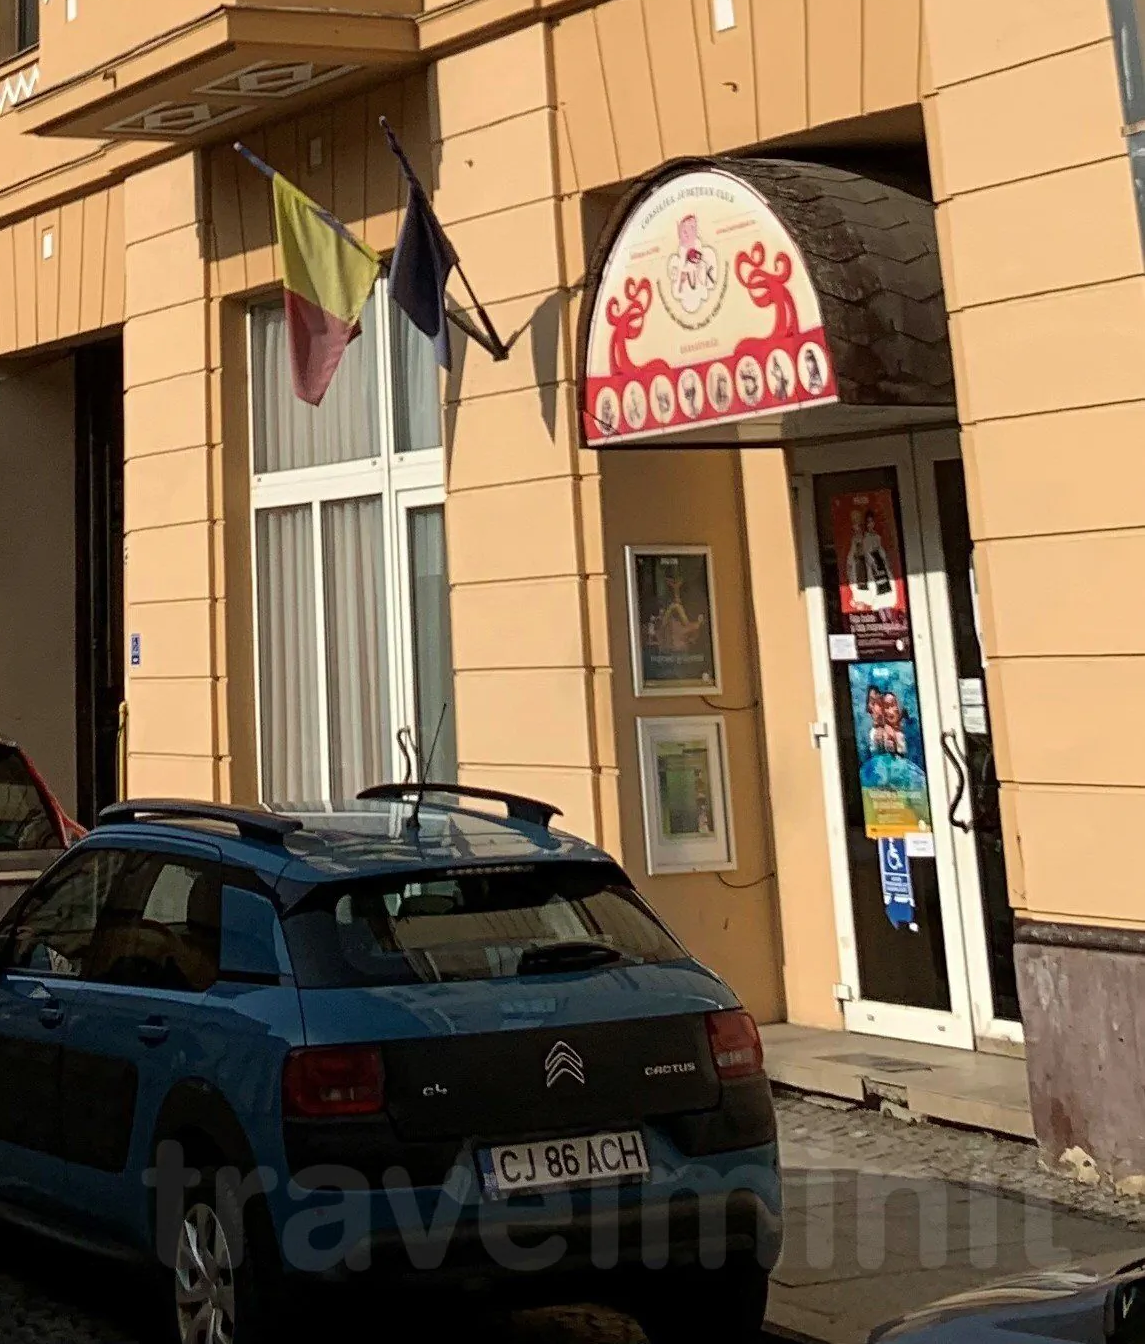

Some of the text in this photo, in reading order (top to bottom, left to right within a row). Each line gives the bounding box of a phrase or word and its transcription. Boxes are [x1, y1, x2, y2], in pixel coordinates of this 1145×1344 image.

[644, 1061, 696, 1076] CACTUS
[421, 1083, 449, 1098] C4
[500, 1134, 644, 1183] CJ 86 ACH
